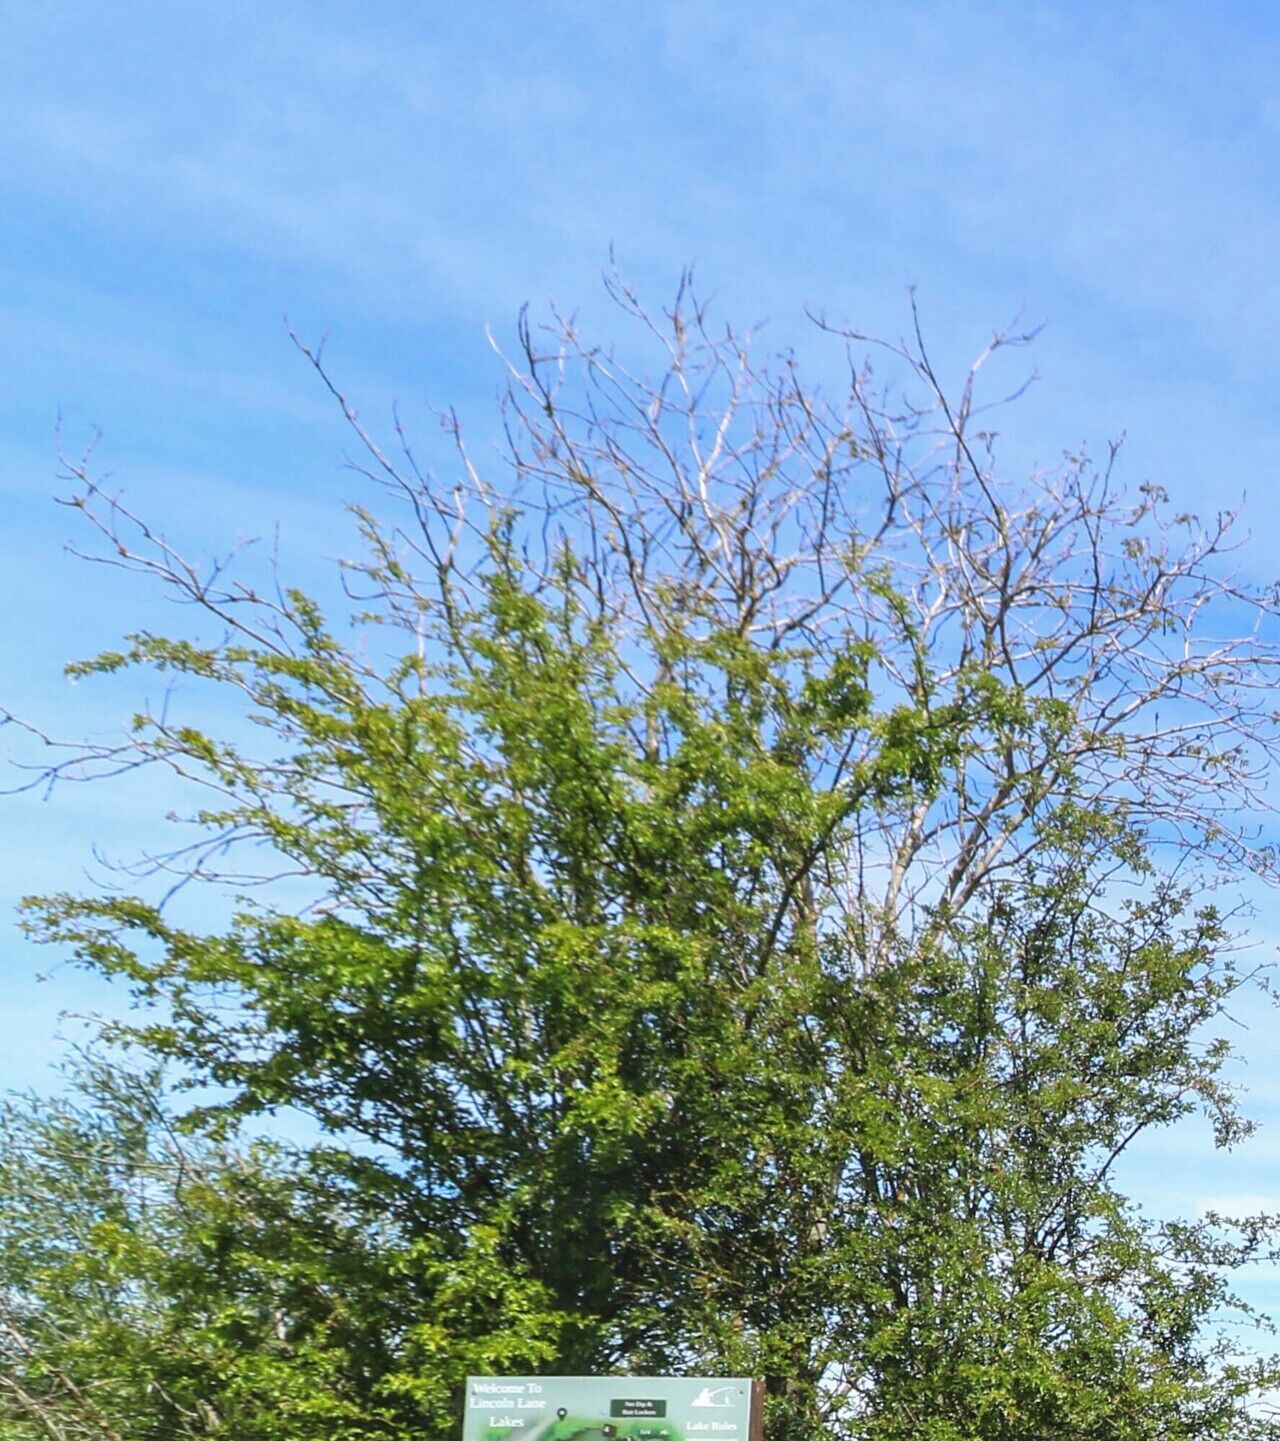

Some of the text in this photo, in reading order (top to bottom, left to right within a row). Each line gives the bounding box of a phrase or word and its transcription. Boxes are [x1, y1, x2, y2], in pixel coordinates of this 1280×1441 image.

[472, 1383, 542, 1393] Welcome To
[470, 1397, 546, 1408] Lincoln Lane
[489, 1416, 524, 1427] Lakes
[686, 1421, 737, 1431] Lake Rules
